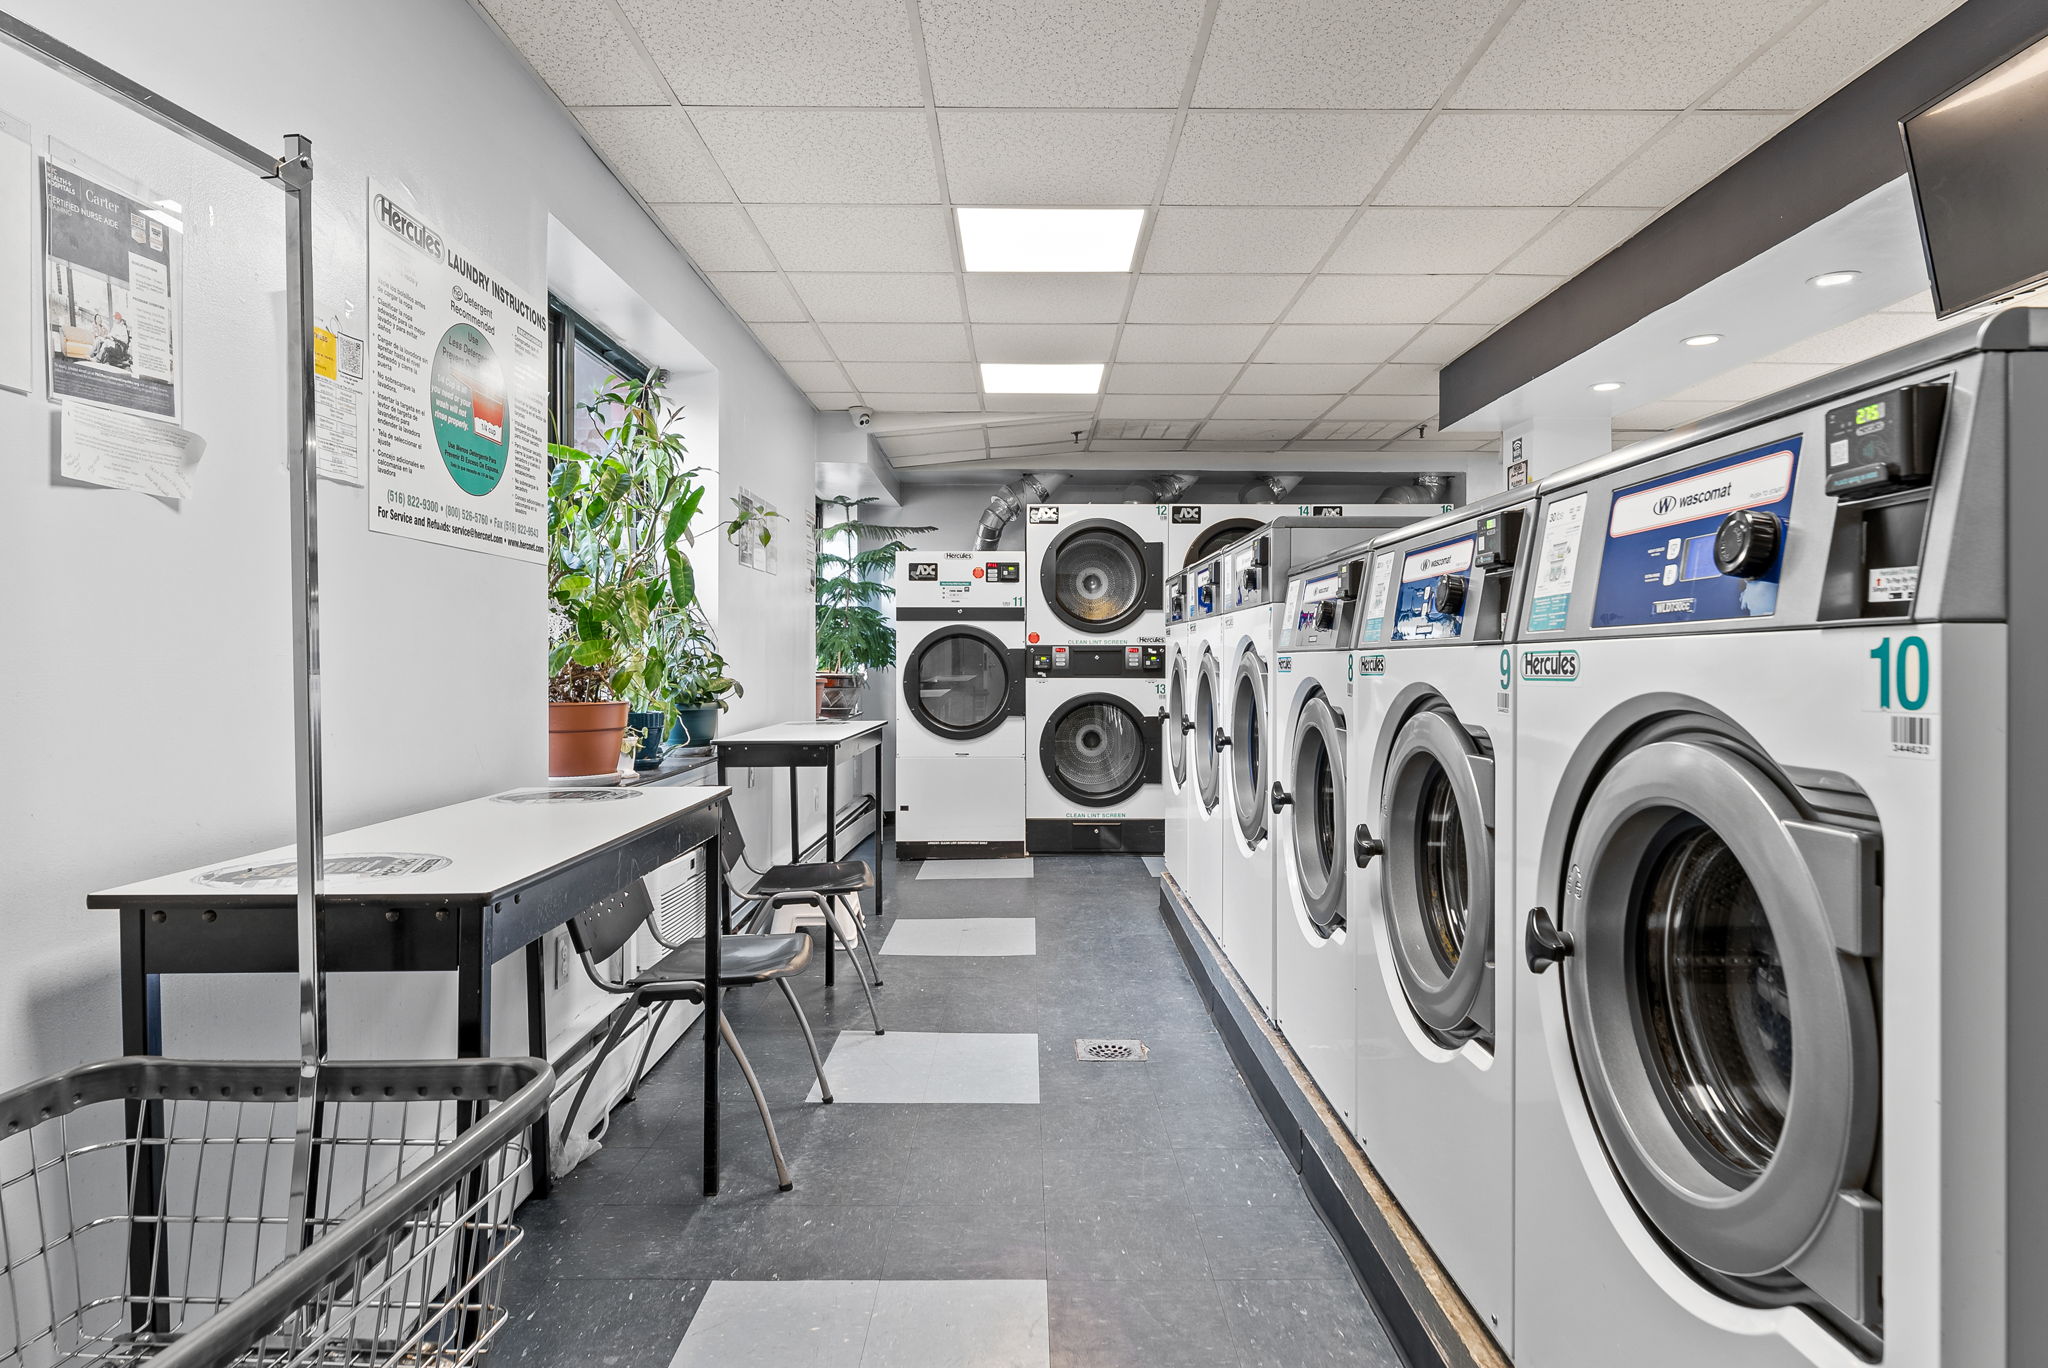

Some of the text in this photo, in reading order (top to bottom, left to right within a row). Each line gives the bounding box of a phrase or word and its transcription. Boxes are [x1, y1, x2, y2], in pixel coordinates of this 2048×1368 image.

[48, 194, 80, 213] CERTIFIED
[81, 208, 102, 222] NURSE
[104, 218, 119, 230] AIDE
[85, 190, 120, 214] Carter
[380, 196, 442, 259] Hercules
[448, 249, 490, 292] LAUNDRY
[492, 280, 547, 332] INSTRUCTIONS
[464, 292, 493, 319] Detergent
[450, 300, 496, 336] Recommended
[448, 336, 462, 350] Less
[468, 332, 479, 345] Use
[1679, 482, 1732, 508] wascomat
[387, 488, 405, 507] (516)
[407, 495, 438, 512] 822-9300
[445, 505, 460, 517] (800)
[462, 510, 488, 525] 526-5760
[493, 518, 503, 529] Fax
[504, 522, 516, 535] (516)
[1156, 506, 1167, 515] 12
[1180, 507, 1198, 518] ADC
[1298, 506, 1308, 516] 14
[1441, 505, 1452, 514] 16
[377, 506, 545, 553] For Service and Refunds: service@hercnet.com www.hercnet.com
[916, 565, 936, 575] ADC
[1431, 555, 1452, 568] wascomat
[1013, 597, 1023, 606] 11
[1348, 654, 1353, 682] 8
[1361, 657, 1384, 672] Hercules
[1500, 649, 1511, 690] 9
[1524, 653, 1576, 676] Hercules
[1870, 635, 1930, 711] 10
[1155, 684, 1166, 694] 13
